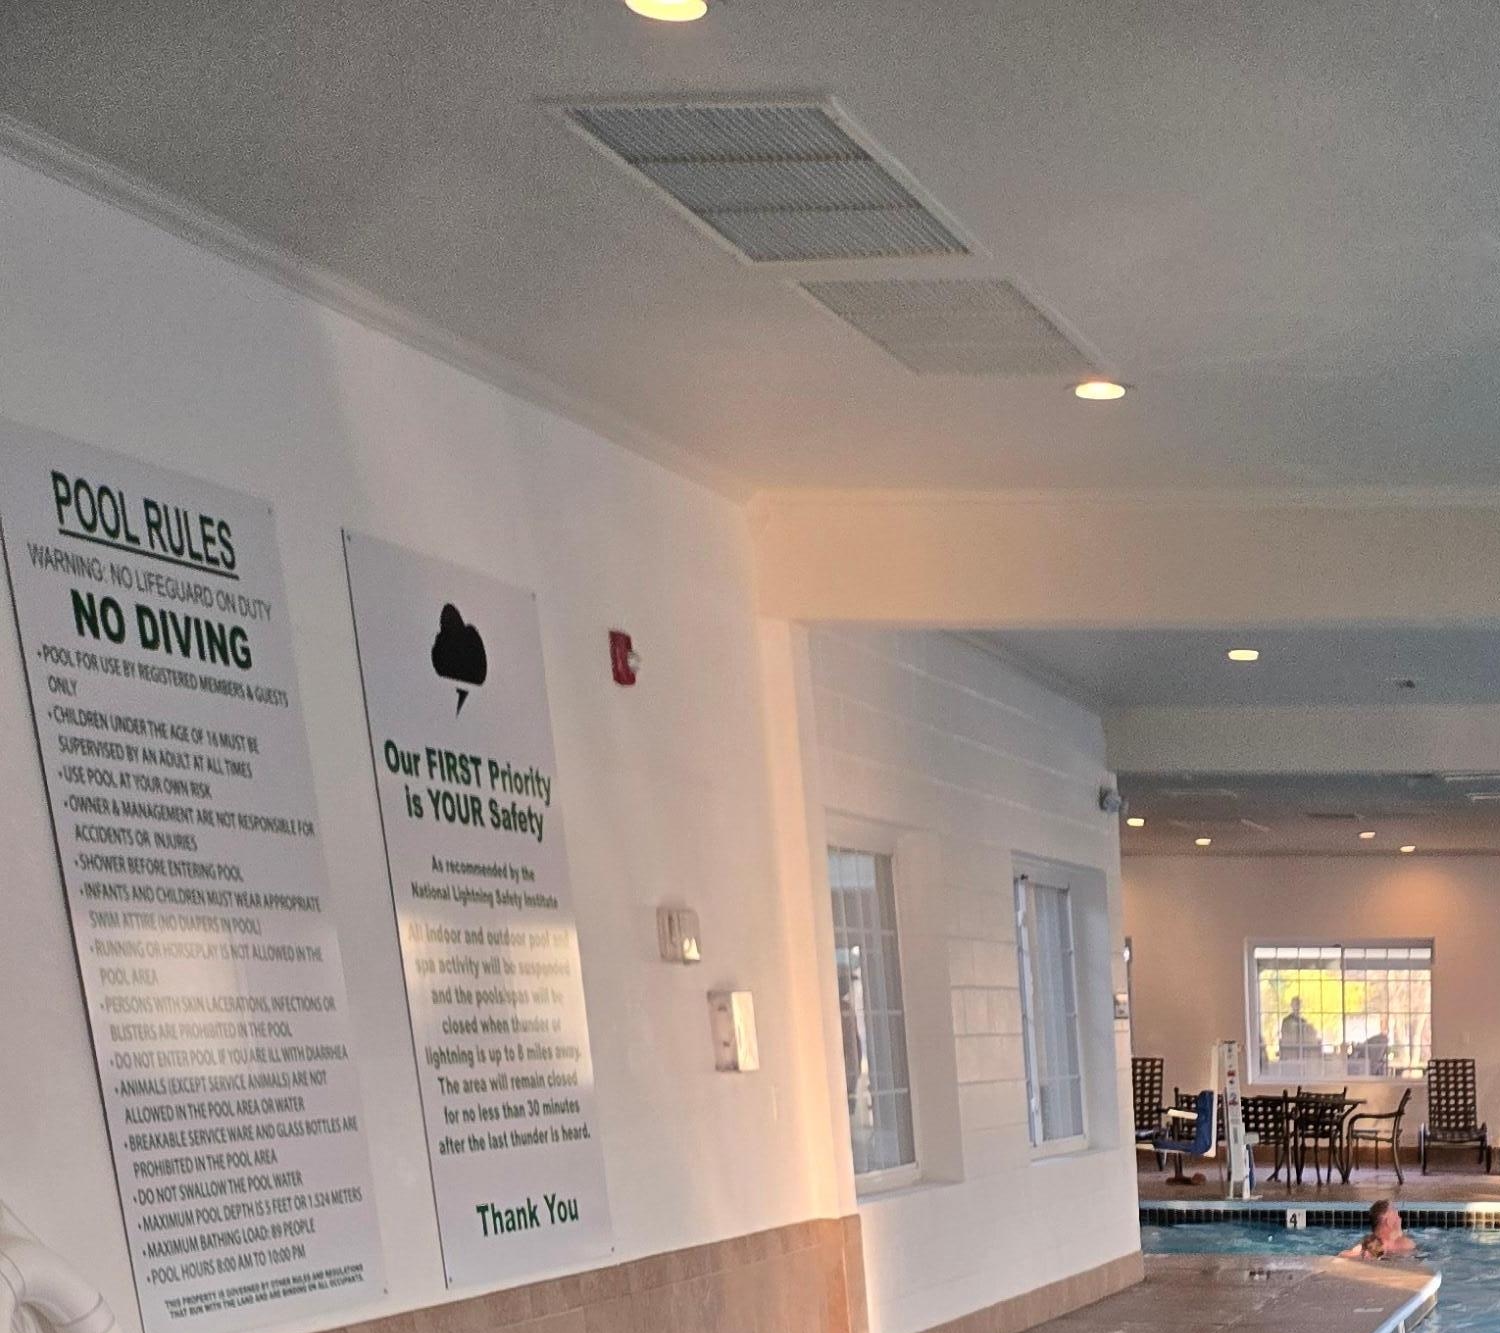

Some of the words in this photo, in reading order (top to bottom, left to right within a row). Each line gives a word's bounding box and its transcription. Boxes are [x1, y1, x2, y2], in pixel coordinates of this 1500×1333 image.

[50, 471, 140, 546] POOL
[142, 498, 236, 570] RULES
[27, 543, 108, 584] WARNING:
[108, 562, 135, 591] NO
[134, 569, 215, 609] LIFEGUARD
[214, 588, 237, 615] ON
[236, 594, 272, 623] DUTY
[69, 589, 127, 643] NO
[134, 604, 252, 669] DIVING
[41, 646, 74, 669] POOL
[75, 652, 100, 674] FOR
[99, 656, 122, 677] USE
[121, 661, 137, 680] BY
[137, 664, 199, 691] REGISTERED
[198, 675, 245, 699] MEMBERS
[245, 684, 254, 701] &
[253, 686, 288, 707] GUESTS
[46, 675, 78, 697] ONLY
[52, 707, 109, 732] CHILDREN
[109, 715, 148, 737] UNDER
[147, 721, 168, 740] THE
[168, 725, 190, 743] AGE
[190, 728, 204, 745] OF
[218, 732, 246, 751] MUST
[246, 737, 259, 753] BE
[57, 736, 125, 761] SUPERVISED
[125, 745, 140, 764] BY
[140, 747, 158, 766] AN
[157, 750, 191, 770] ADULT
[191, 754, 205, 772] AT
[205, 756, 223, 774] ALL
[224, 759, 252, 778] TIMES
[382, 738, 422, 778] Our
[424, 747, 485, 791] FIRST
[487, 759, 552, 805] Priority
[62, 766, 86, 785] USE
[86, 768, 116, 788] POOL
[118, 772, 132, 790] AT
[132, 774, 163, 793] YOUR
[162, 777, 189, 796] OWN
[188, 781, 212, 798] RISK
[404, 784, 424, 819] is
[427, 789, 485, 829] YOUR
[487, 799, 545, 840] Safety
[73, 825, 134, 846] ACCIDENTS
[134, 830, 151, 848] OR
[153, 832, 197, 851] INJURIES
[78, 854, 126, 873] SHOWER
[126, 858, 167, 876] BEFORE
[166, 860, 216, 879] ENTERING
[216, 864, 242, 881] POOL
[430, 854, 443, 871] As
[444, 856, 508, 878] recommended
[508, 863, 520, 883] by
[520, 865, 534, 882] the
[410, 881, 451, 900] National
[451, 885, 494, 906] Lightning
[494, 889, 523, 909] Safety
[523, 891, 558, 909] Institute
[425, 1045, 475, 1068] lightning
[475, 1045, 486, 1063] is
[488, 1048, 502, 1065] up
[503, 1044, 515, 1062] to
[516, 1044, 524, 1061] 8
[525, 1043, 553, 1061] miles
[118, 1077, 167, 1098] ANIMALS
[207, 1073, 246, 1092] SERVICE
[290, 1070, 308, 1086] ARE
[308, 1069, 327, 1085] NOT
[437, 1075, 460, 1095] The
[461, 1077, 487, 1093] area
[488, 1072, 509, 1091] will
[509, 1070, 545, 1090] remain
[546, 1068, 577, 1087] closed
[123, 1105, 175, 1126] ALLOWED
[174, 1104, 187, 1121] IN
[187, 1103, 207, 1120] THE
[207, 1101, 233, 1118] POOL
[235, 1099, 260, 1116] AREA
[260, 1098, 275, 1114] OR
[274, 1096, 304, 1113] WATER
[443, 1106, 459, 1125] for
[461, 1108, 476, 1123] no
[477, 1102, 500, 1122] less
[501, 1100, 526, 1119] than
[526, 1099, 540, 1117] 30
[541, 1096, 580, 1115] minutes
[128, 1129, 187, 1153] BREAKABLE
[254, 1122, 276, 1140] AND
[275, 1120, 304, 1138] GLASS
[304, 1116, 341, 1135] BOTTLES
[341, 1115, 357, 1131] ARE
[437, 1134, 466, 1156] after
[467, 1132, 486, 1153] the
[487, 1130, 508, 1151] last
[509, 1126, 548, 1148] thunder
[549, 1124, 560, 1144] is
[560, 1121, 590, 1142] heard.
[133, 1157, 194, 1181] PROHIBITED
[194, 1156, 206, 1173] IN
[206, 1154, 225, 1171] THE
[225, 1151, 251, 1169] POOL
[252, 1148, 277, 1166] AREA
[137, 1188, 155, 1206] DO
[155, 1185, 178, 1204] NOT
[178, 1179, 227, 1201] SWALLOW
[228, 1177, 246, 1194] THE
[246, 1173, 271, 1192] POOL
[272, 1169, 302, 1189] WATER
[142, 1209, 195, 1234] MAXIMUM
[194, 1206, 222, 1226] POOL
[222, 1201, 255, 1222] DEPTH
[254, 1200, 265, 1217] IS
[264, 1199, 271, 1215] 5
[271, 1196, 293, 1214] FEET
[292, 1194, 307, 1211] OR
[330, 1186, 362, 1205] METERS
[476, 1196, 540, 1238] Thank
[544, 1190, 579, 1225] You
[146, 1235, 199, 1260] MAXIMUM
[199, 1229, 242, 1251] BATHING
[270, 1222, 283, 1239] 89
[282, 1217, 314, 1237] PEOPLE
[150, 1265, 179, 1286] POOL
[180, 1259, 215, 1281] HOURS
[215, 1255, 237, 1274] 8:00
[236, 1252, 253, 1270] AM
[253, 1250, 267, 1267] TO
[267, 1246, 291, 1264] 10:00
[291, 1243, 306, 1260] PM
